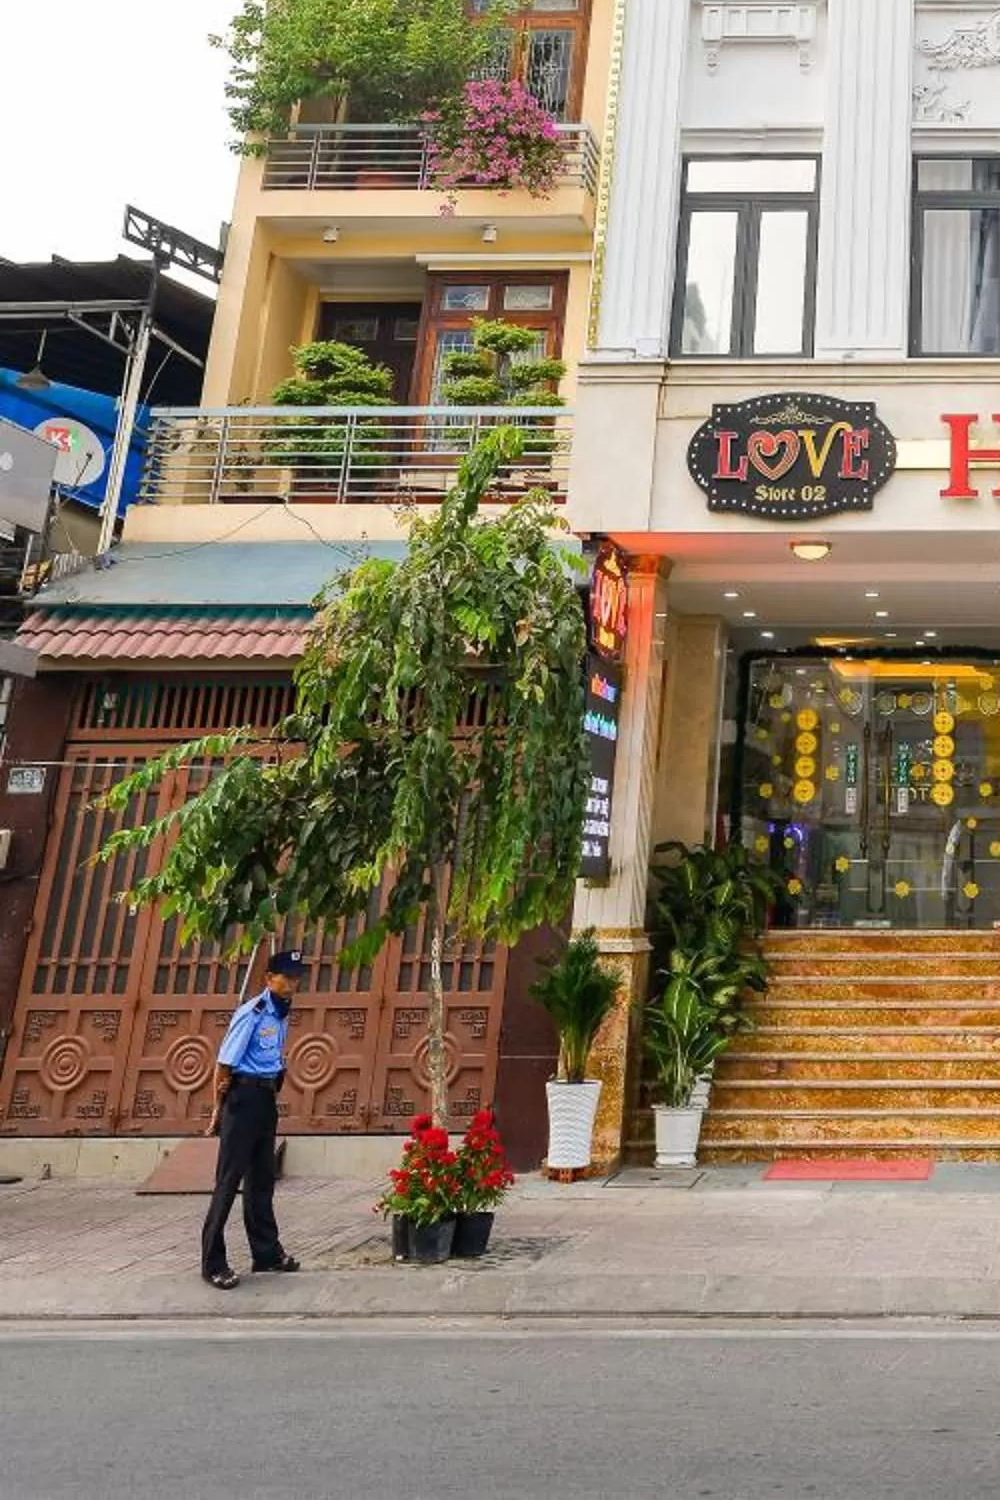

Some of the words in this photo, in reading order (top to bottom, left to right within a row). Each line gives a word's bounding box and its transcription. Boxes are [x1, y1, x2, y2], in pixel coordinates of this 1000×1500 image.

[712, 421, 872, 482] LOVE
[755, 484, 796, 503] Store
[801, 485, 827, 502] 02
